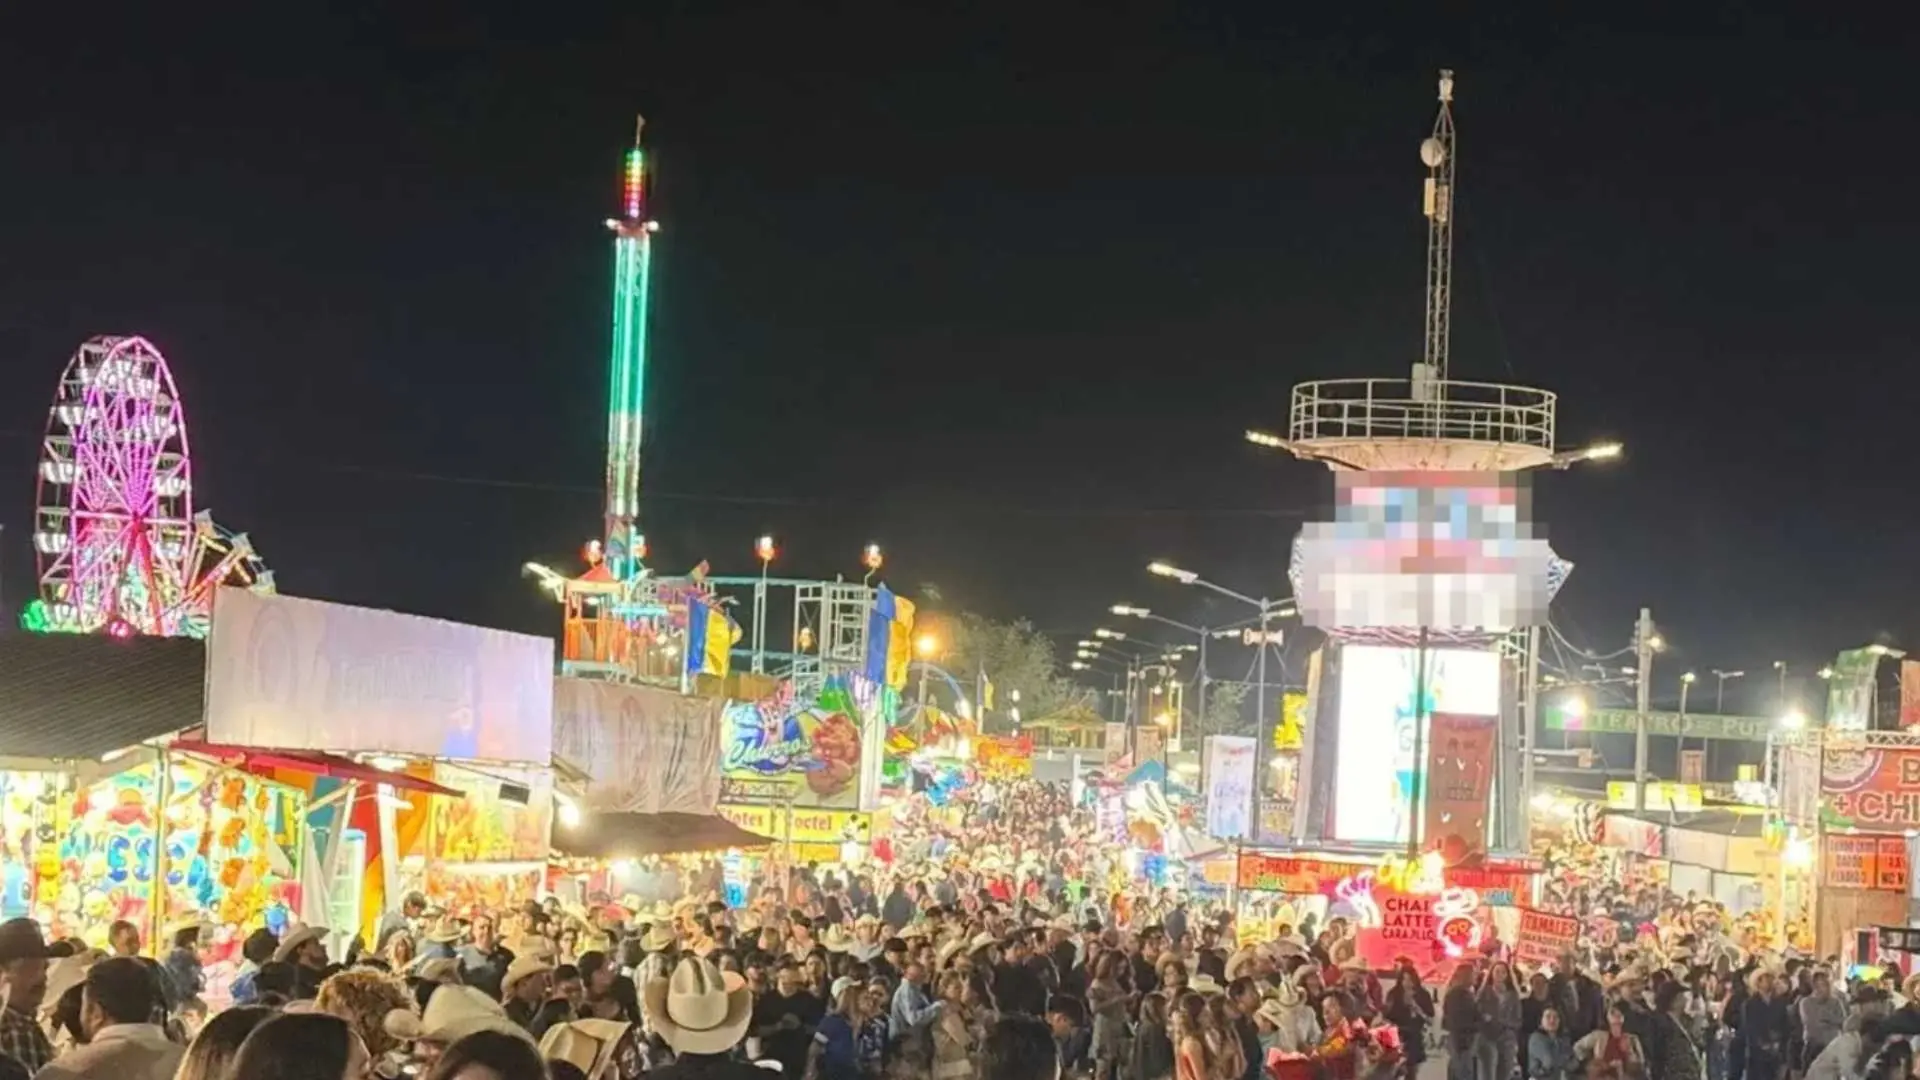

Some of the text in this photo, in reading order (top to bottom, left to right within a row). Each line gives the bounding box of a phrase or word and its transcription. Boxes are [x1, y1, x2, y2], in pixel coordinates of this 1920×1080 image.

[1722, 717, 1769, 737] PUE
[794, 815, 833, 831] octel
[1385, 898, 1430, 912] CHAI
[1383, 913, 1433, 928] LATTE
